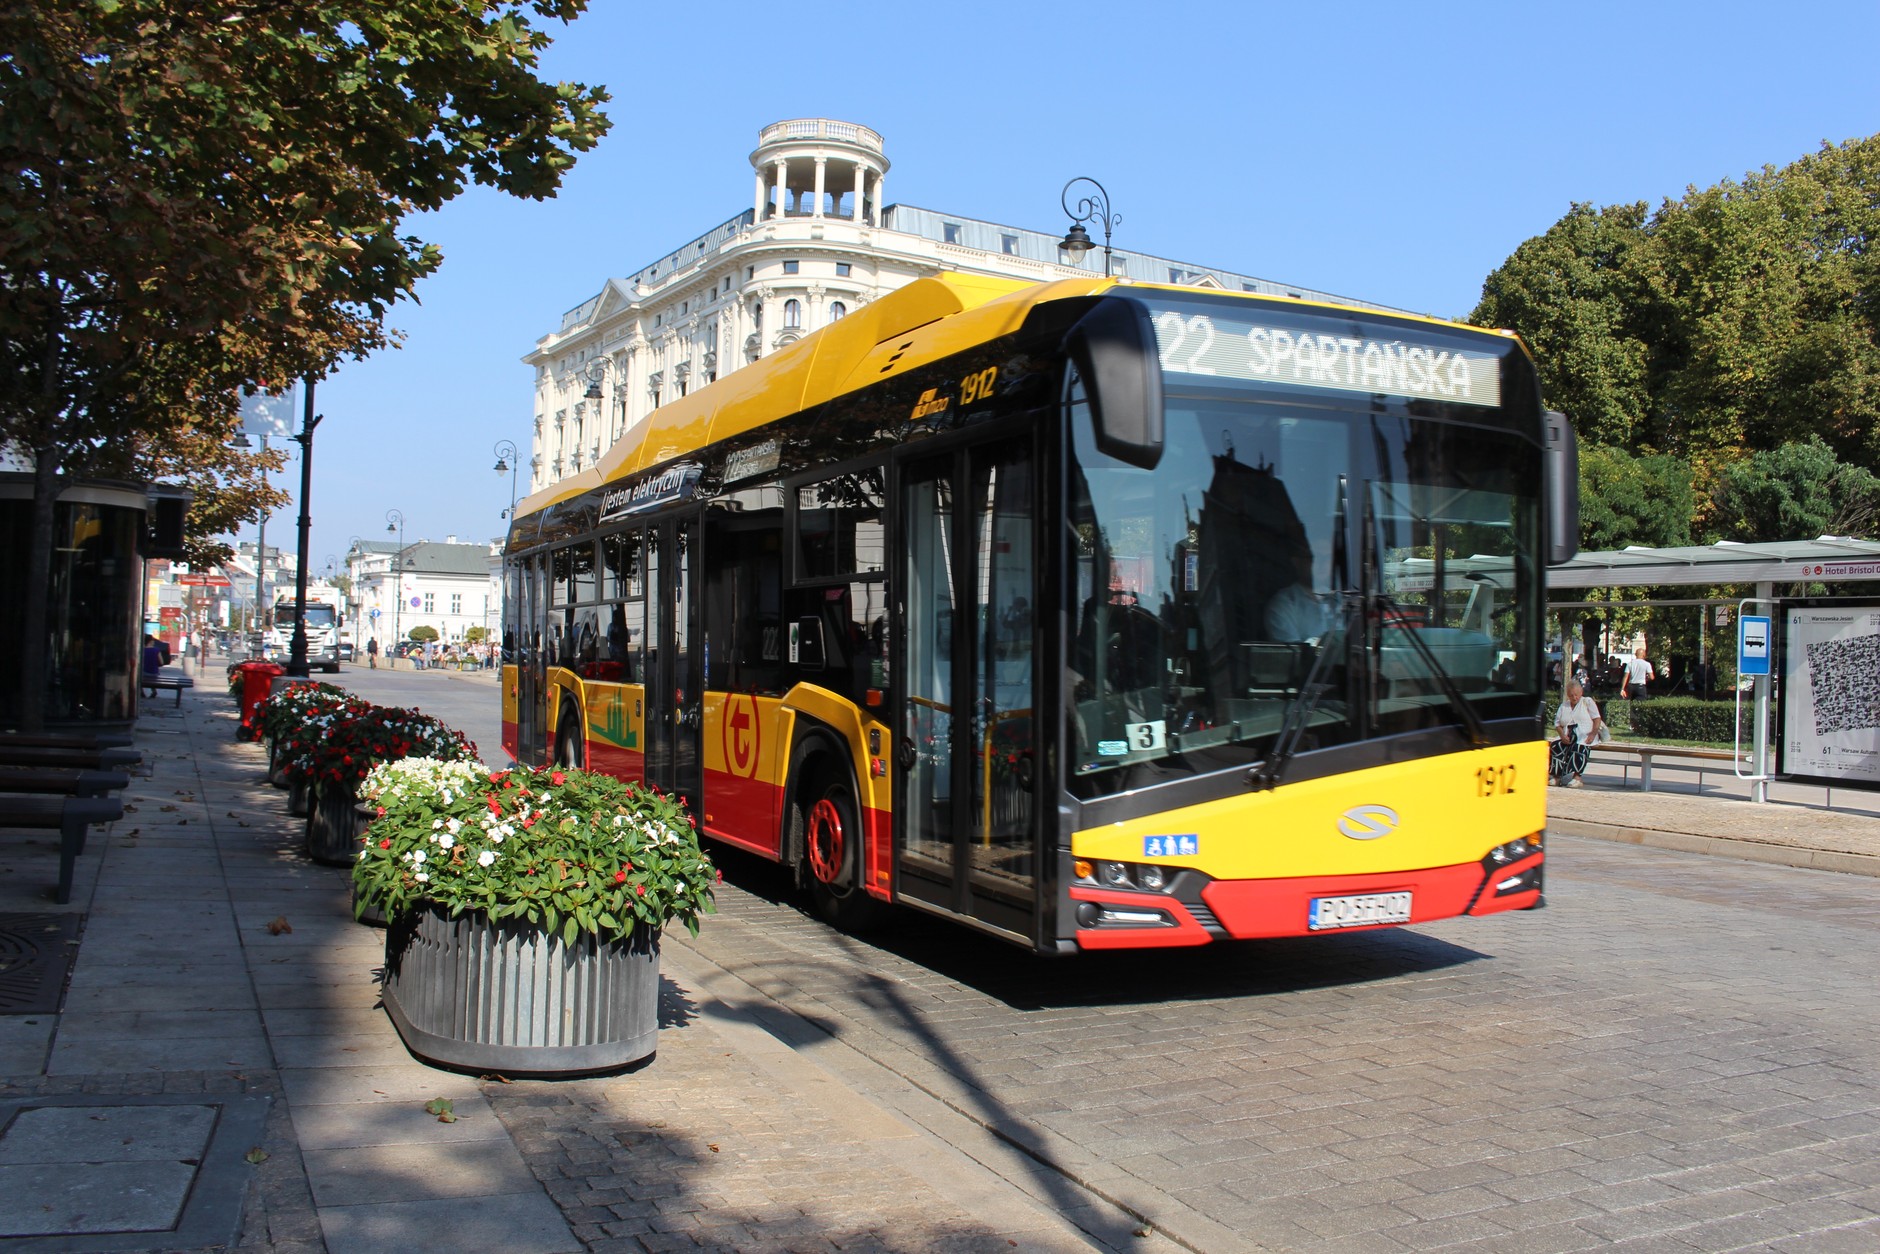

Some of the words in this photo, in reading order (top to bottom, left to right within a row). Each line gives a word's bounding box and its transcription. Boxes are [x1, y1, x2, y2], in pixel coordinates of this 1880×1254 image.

[1247, 327, 1472, 397] SPARTAŃSKA
[960, 366, 998, 406] 1912
[603, 488, 632, 516] jestem
[632, 469, 687, 500] elektryczny
[1825, 566, 1847, 575] Hotel
[1849, 565, 1875, 574] Bristol
[1793, 616, 1802, 625] 61
[1138, 725, 1154, 748] 3
[1823, 746, 1831, 754] 61
[1474, 764, 1517, 797] 1912
